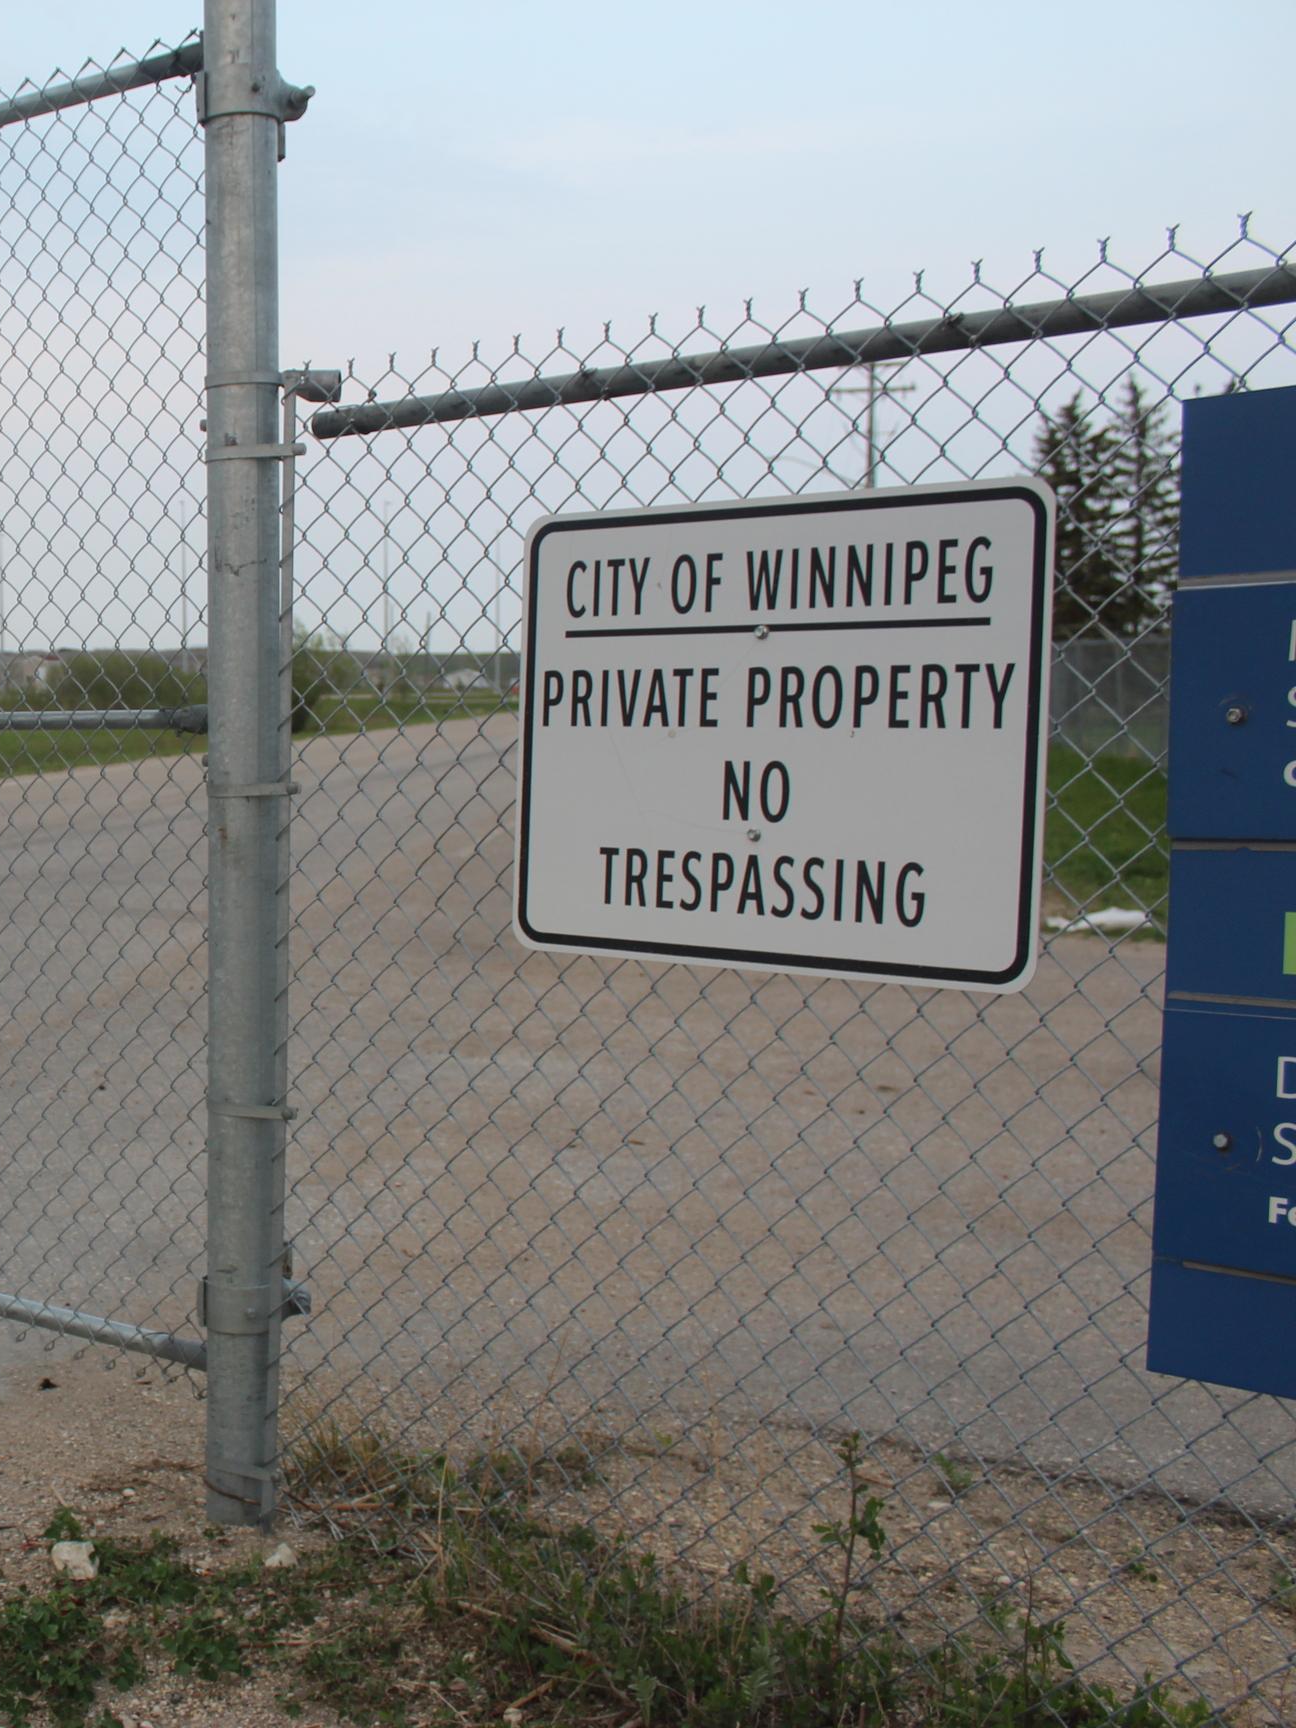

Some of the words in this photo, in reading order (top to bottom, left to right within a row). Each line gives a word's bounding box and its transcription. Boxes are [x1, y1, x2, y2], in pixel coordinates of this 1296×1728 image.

[566, 556, 651, 619] CITY
[671, 552, 724, 615] OF
[746, 536, 994, 611] WINNIPEG
[542, 667, 720, 728] PRIVATE
[746, 662, 1016, 730] PROPERTY
[722, 760, 791, 824] NO
[599, 846, 927, 928] TRESPASSING
